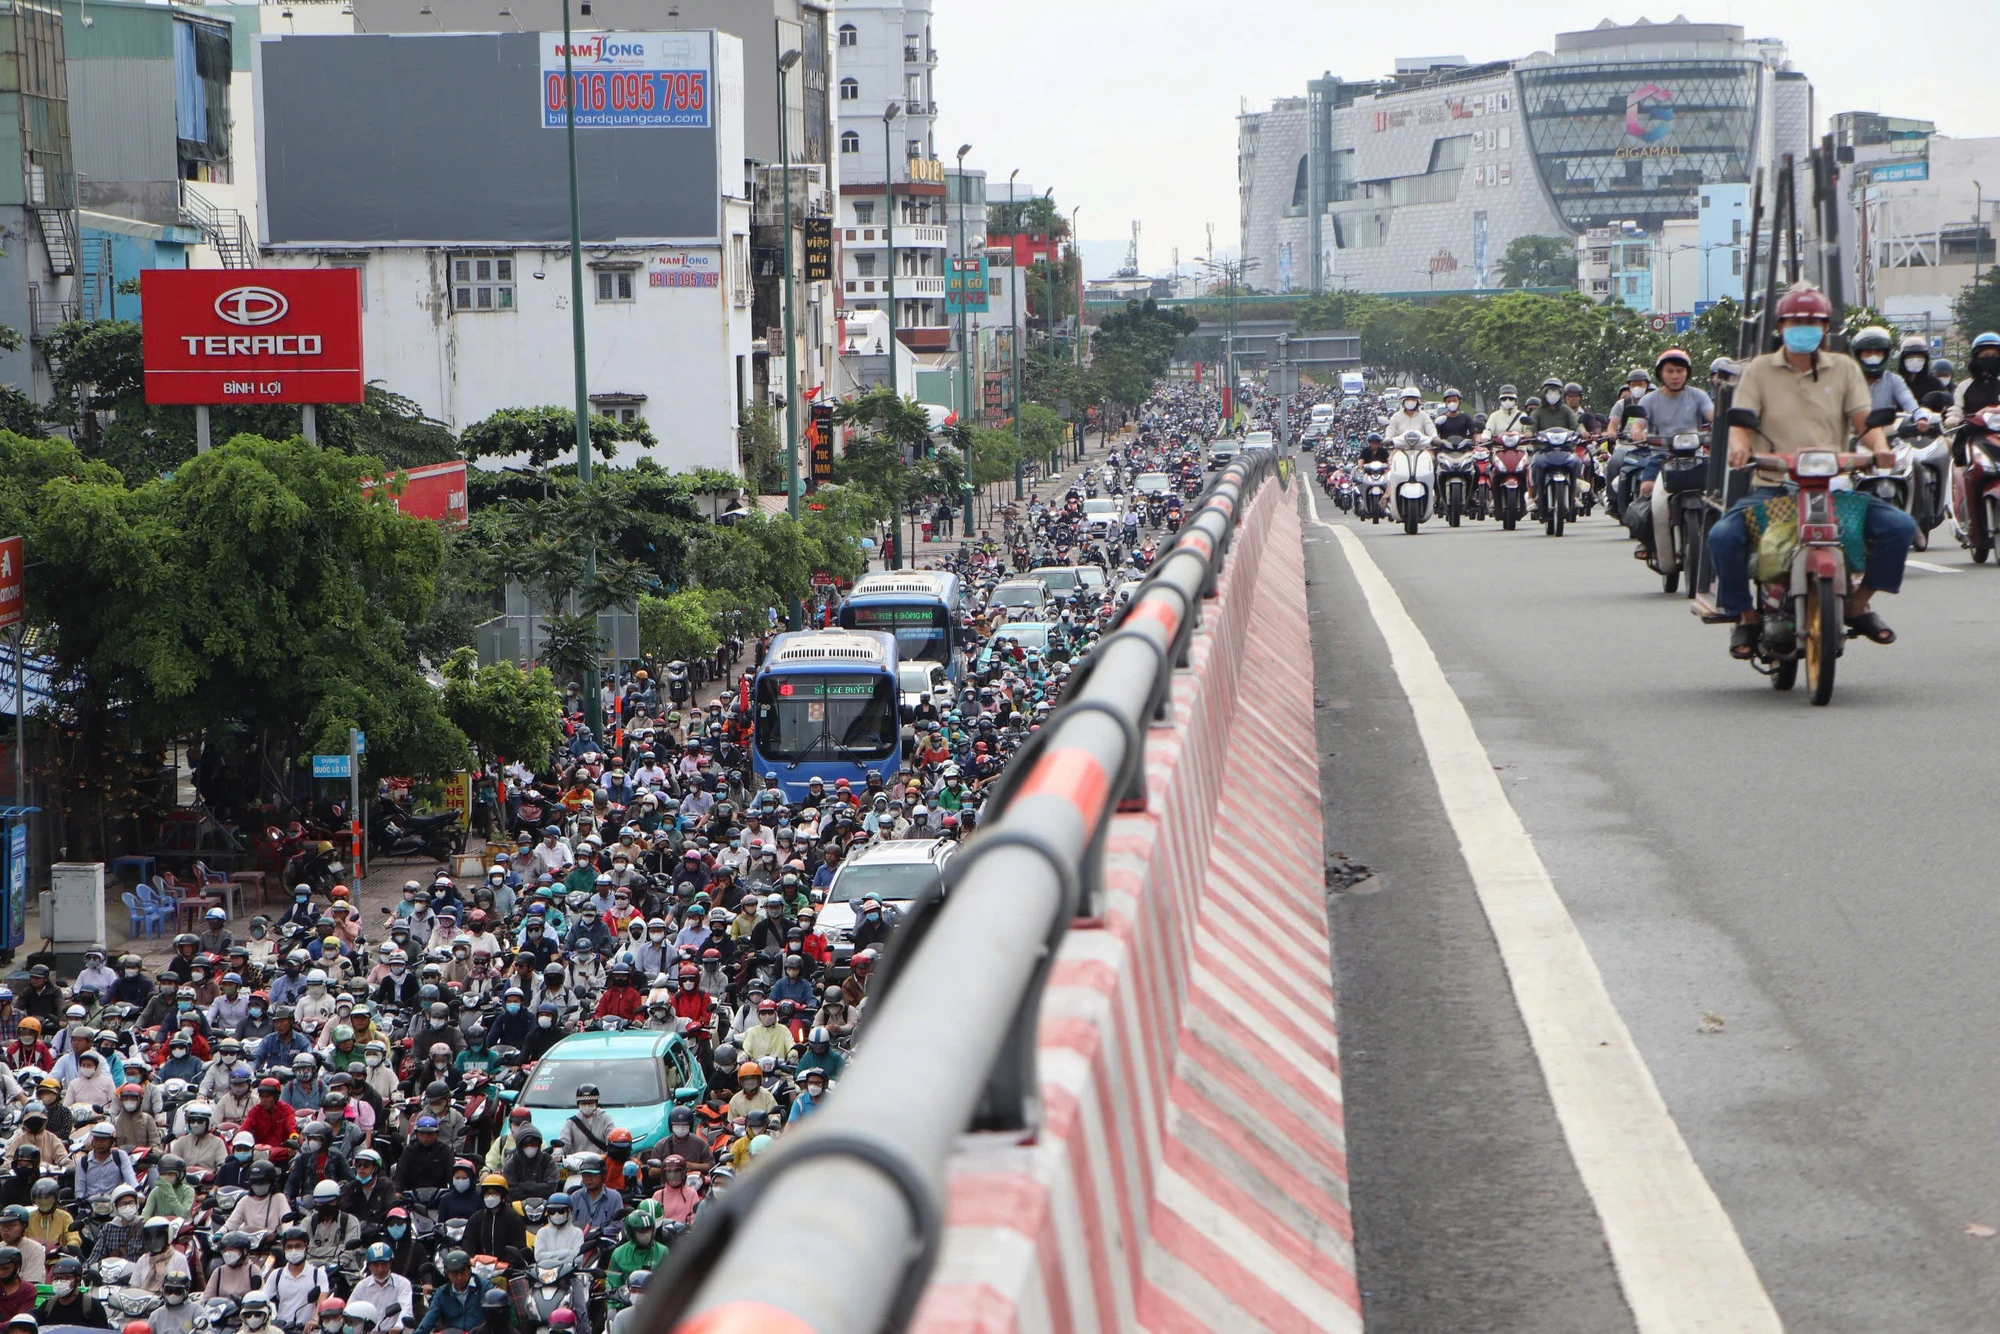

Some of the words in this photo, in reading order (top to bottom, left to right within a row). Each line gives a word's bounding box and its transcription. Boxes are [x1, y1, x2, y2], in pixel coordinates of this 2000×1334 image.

[547, 73, 606, 111] 0916
[611, 73, 655, 111] 095
[661, 73, 704, 111] 795
[549, 112, 703, 126] billoardquangcao.com
[1615, 145, 1685, 159] GIGAMALL
[678, 272, 697, 288] 095
[181, 335, 322, 356] TERACO
[223, 380, 255, 394] BÌNH
[260, 380, 282, 397] LỢI
[808, 702, 824, 720] 8
[314, 764, 330, 773] QUỐC
[331, 764, 340, 776] LỘ
